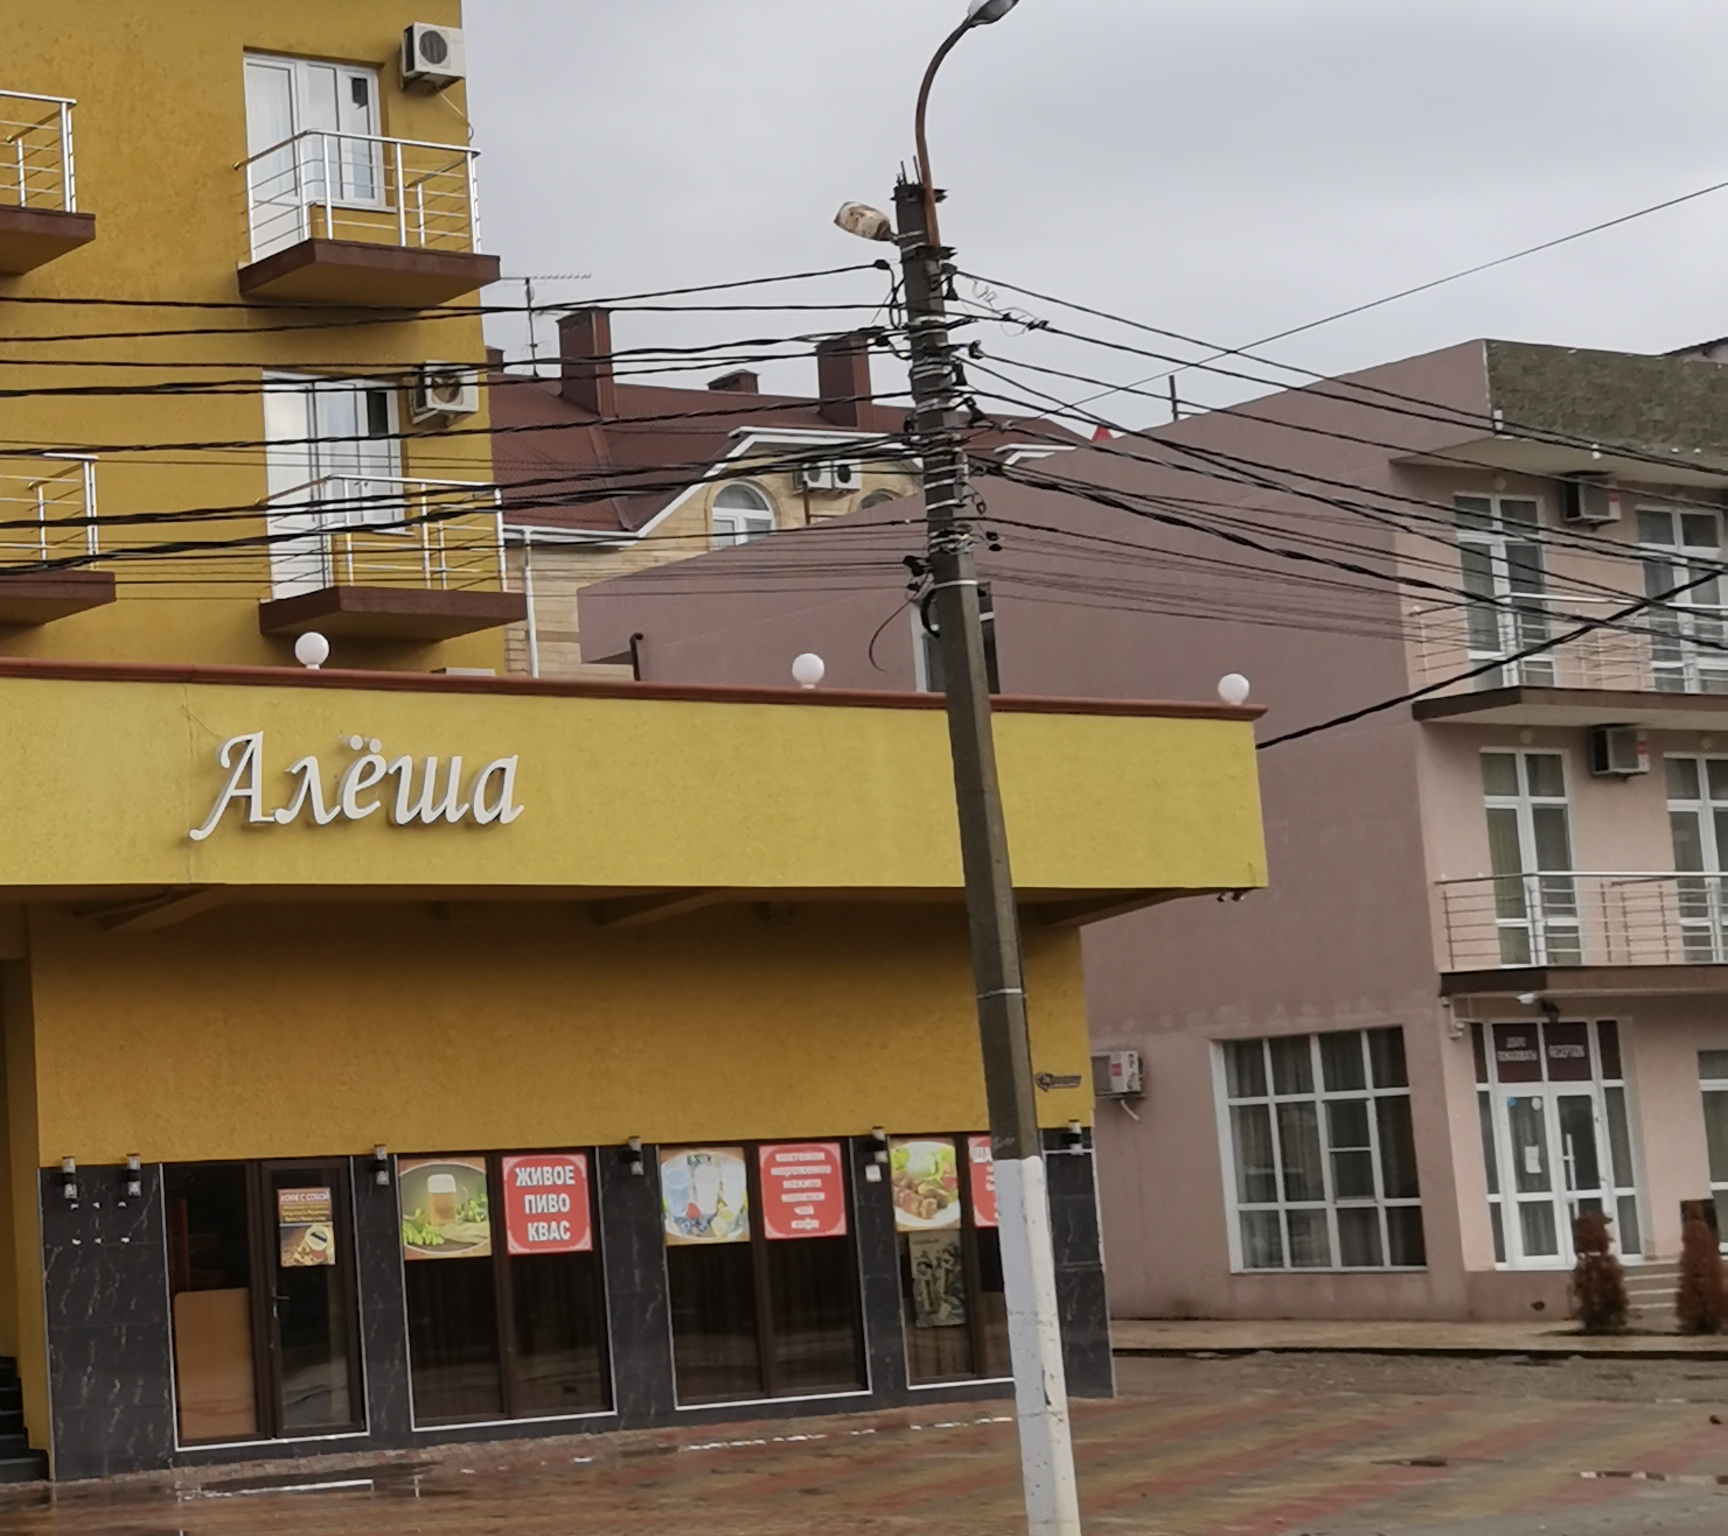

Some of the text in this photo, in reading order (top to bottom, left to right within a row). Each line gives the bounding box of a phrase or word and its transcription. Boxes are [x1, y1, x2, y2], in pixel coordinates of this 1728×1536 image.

[189, 730, 525, 841] Алёша
[514, 1165, 576, 1187] ЖИВОЕ
[523, 1192, 571, 1215] ПИВО
[527, 1219, 571, 1242] КВАС
